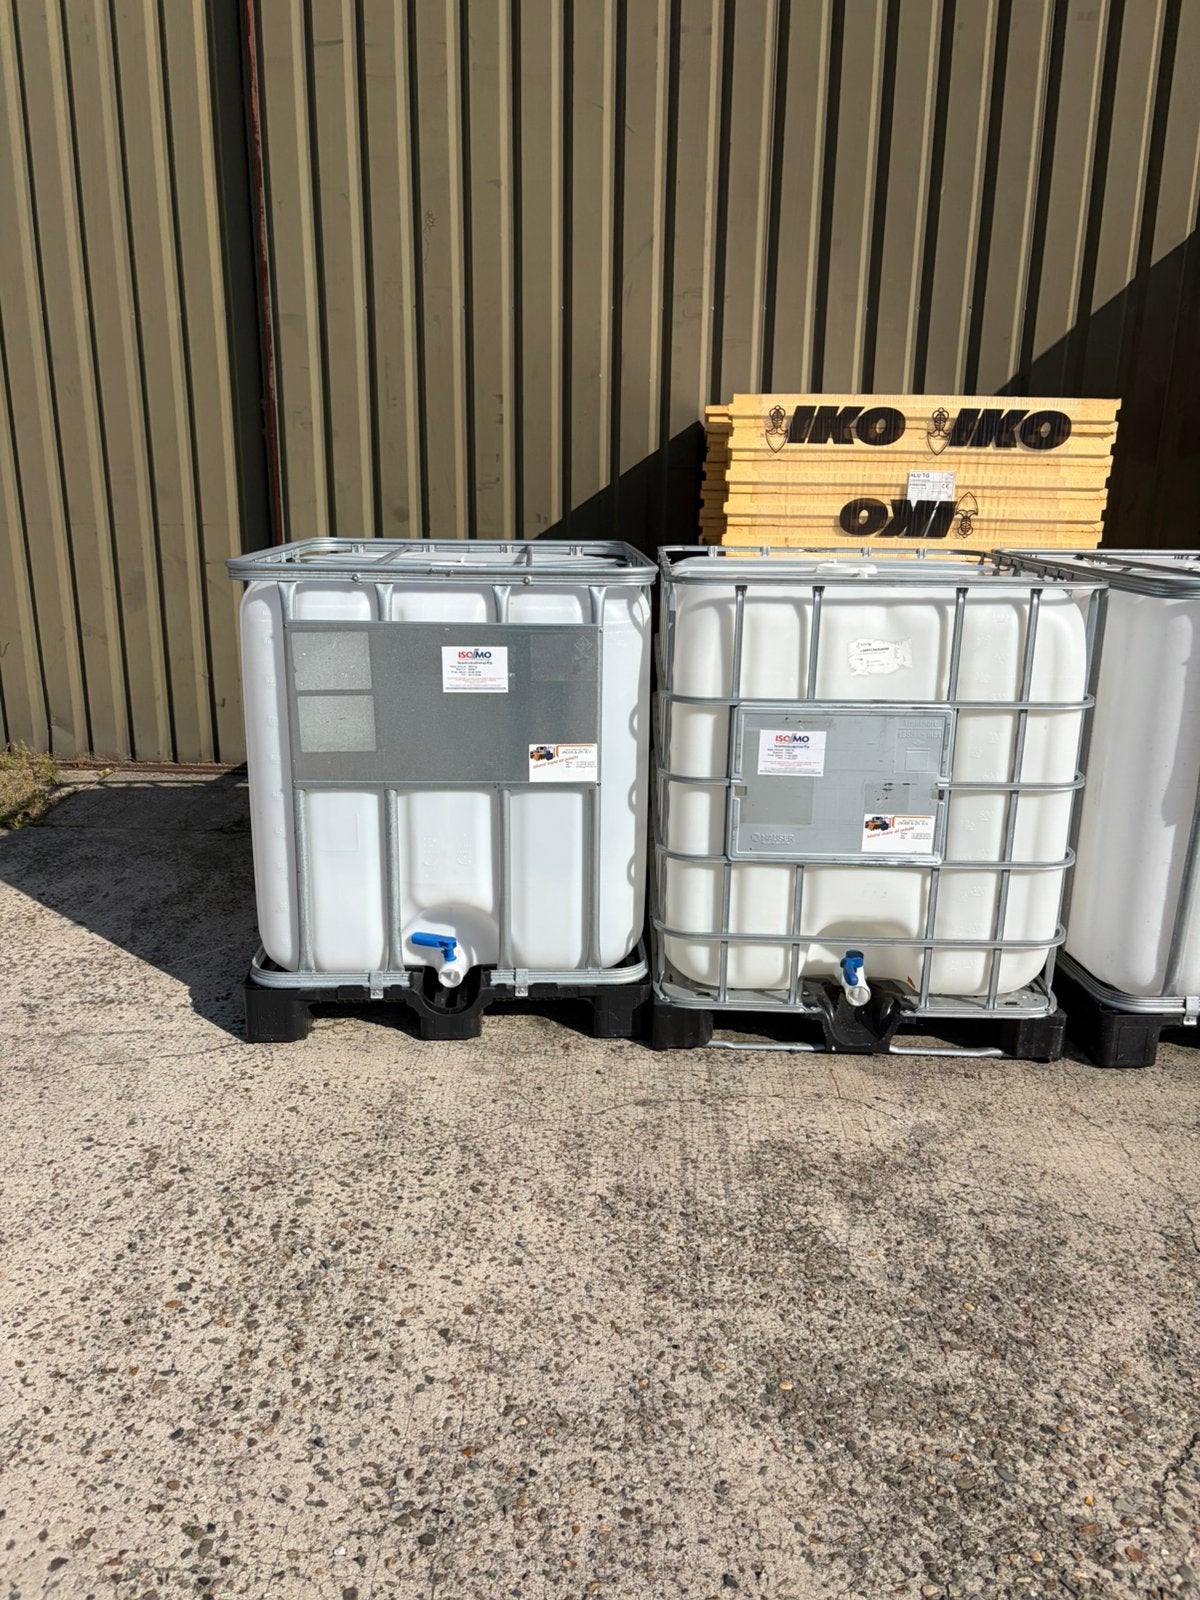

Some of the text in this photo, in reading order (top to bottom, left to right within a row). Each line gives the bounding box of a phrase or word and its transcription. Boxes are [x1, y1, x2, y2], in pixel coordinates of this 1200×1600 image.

[787, 405, 1072, 450] IKO IKO
[838, 497, 957, 538] IKO
